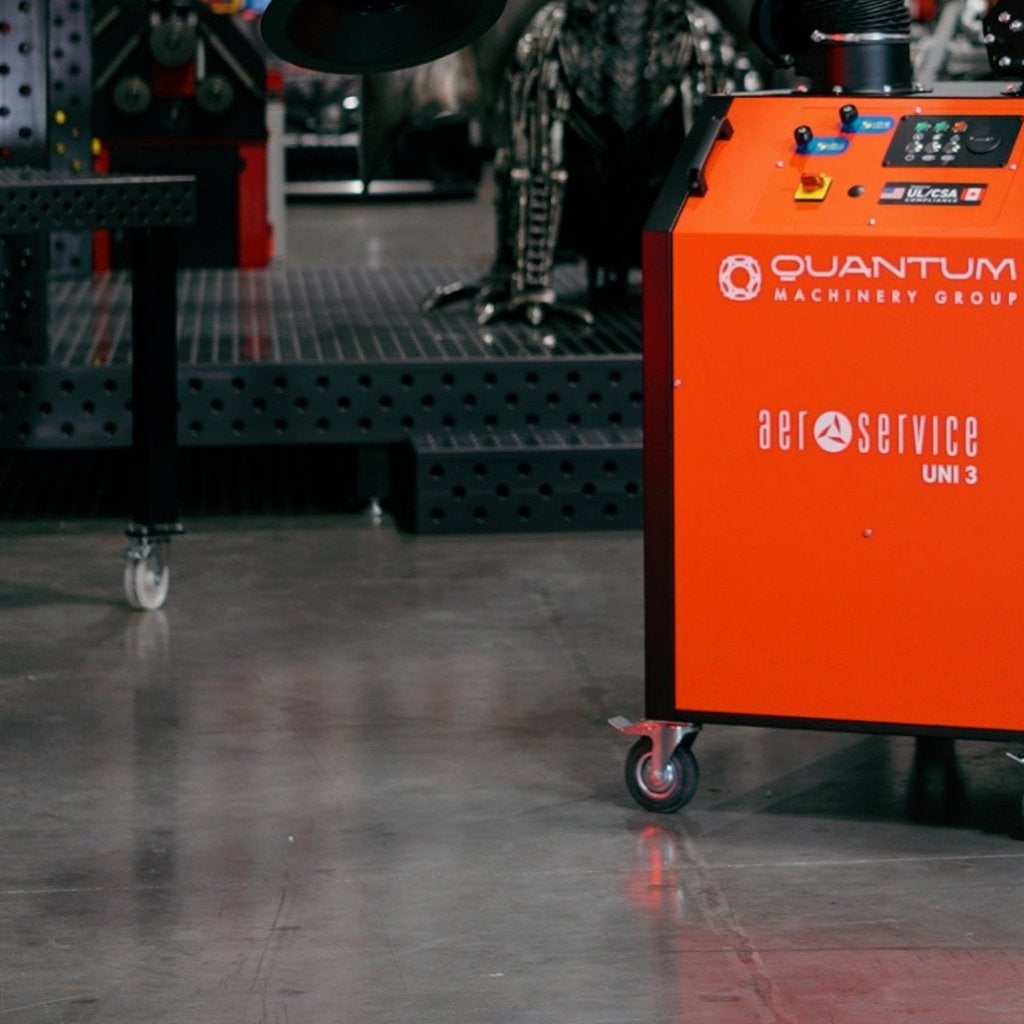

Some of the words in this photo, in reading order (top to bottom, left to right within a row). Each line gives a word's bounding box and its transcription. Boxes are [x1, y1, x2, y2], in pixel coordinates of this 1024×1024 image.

[906, 188, 958, 198] UL/CSA
[770, 254, 1017, 281] QUANTUM
[773, 287, 917, 305] MACHINERY
[935, 290, 1018, 306] GROUP
[921, 464, 960, 484] UNI
[965, 465, 978, 485] 3
